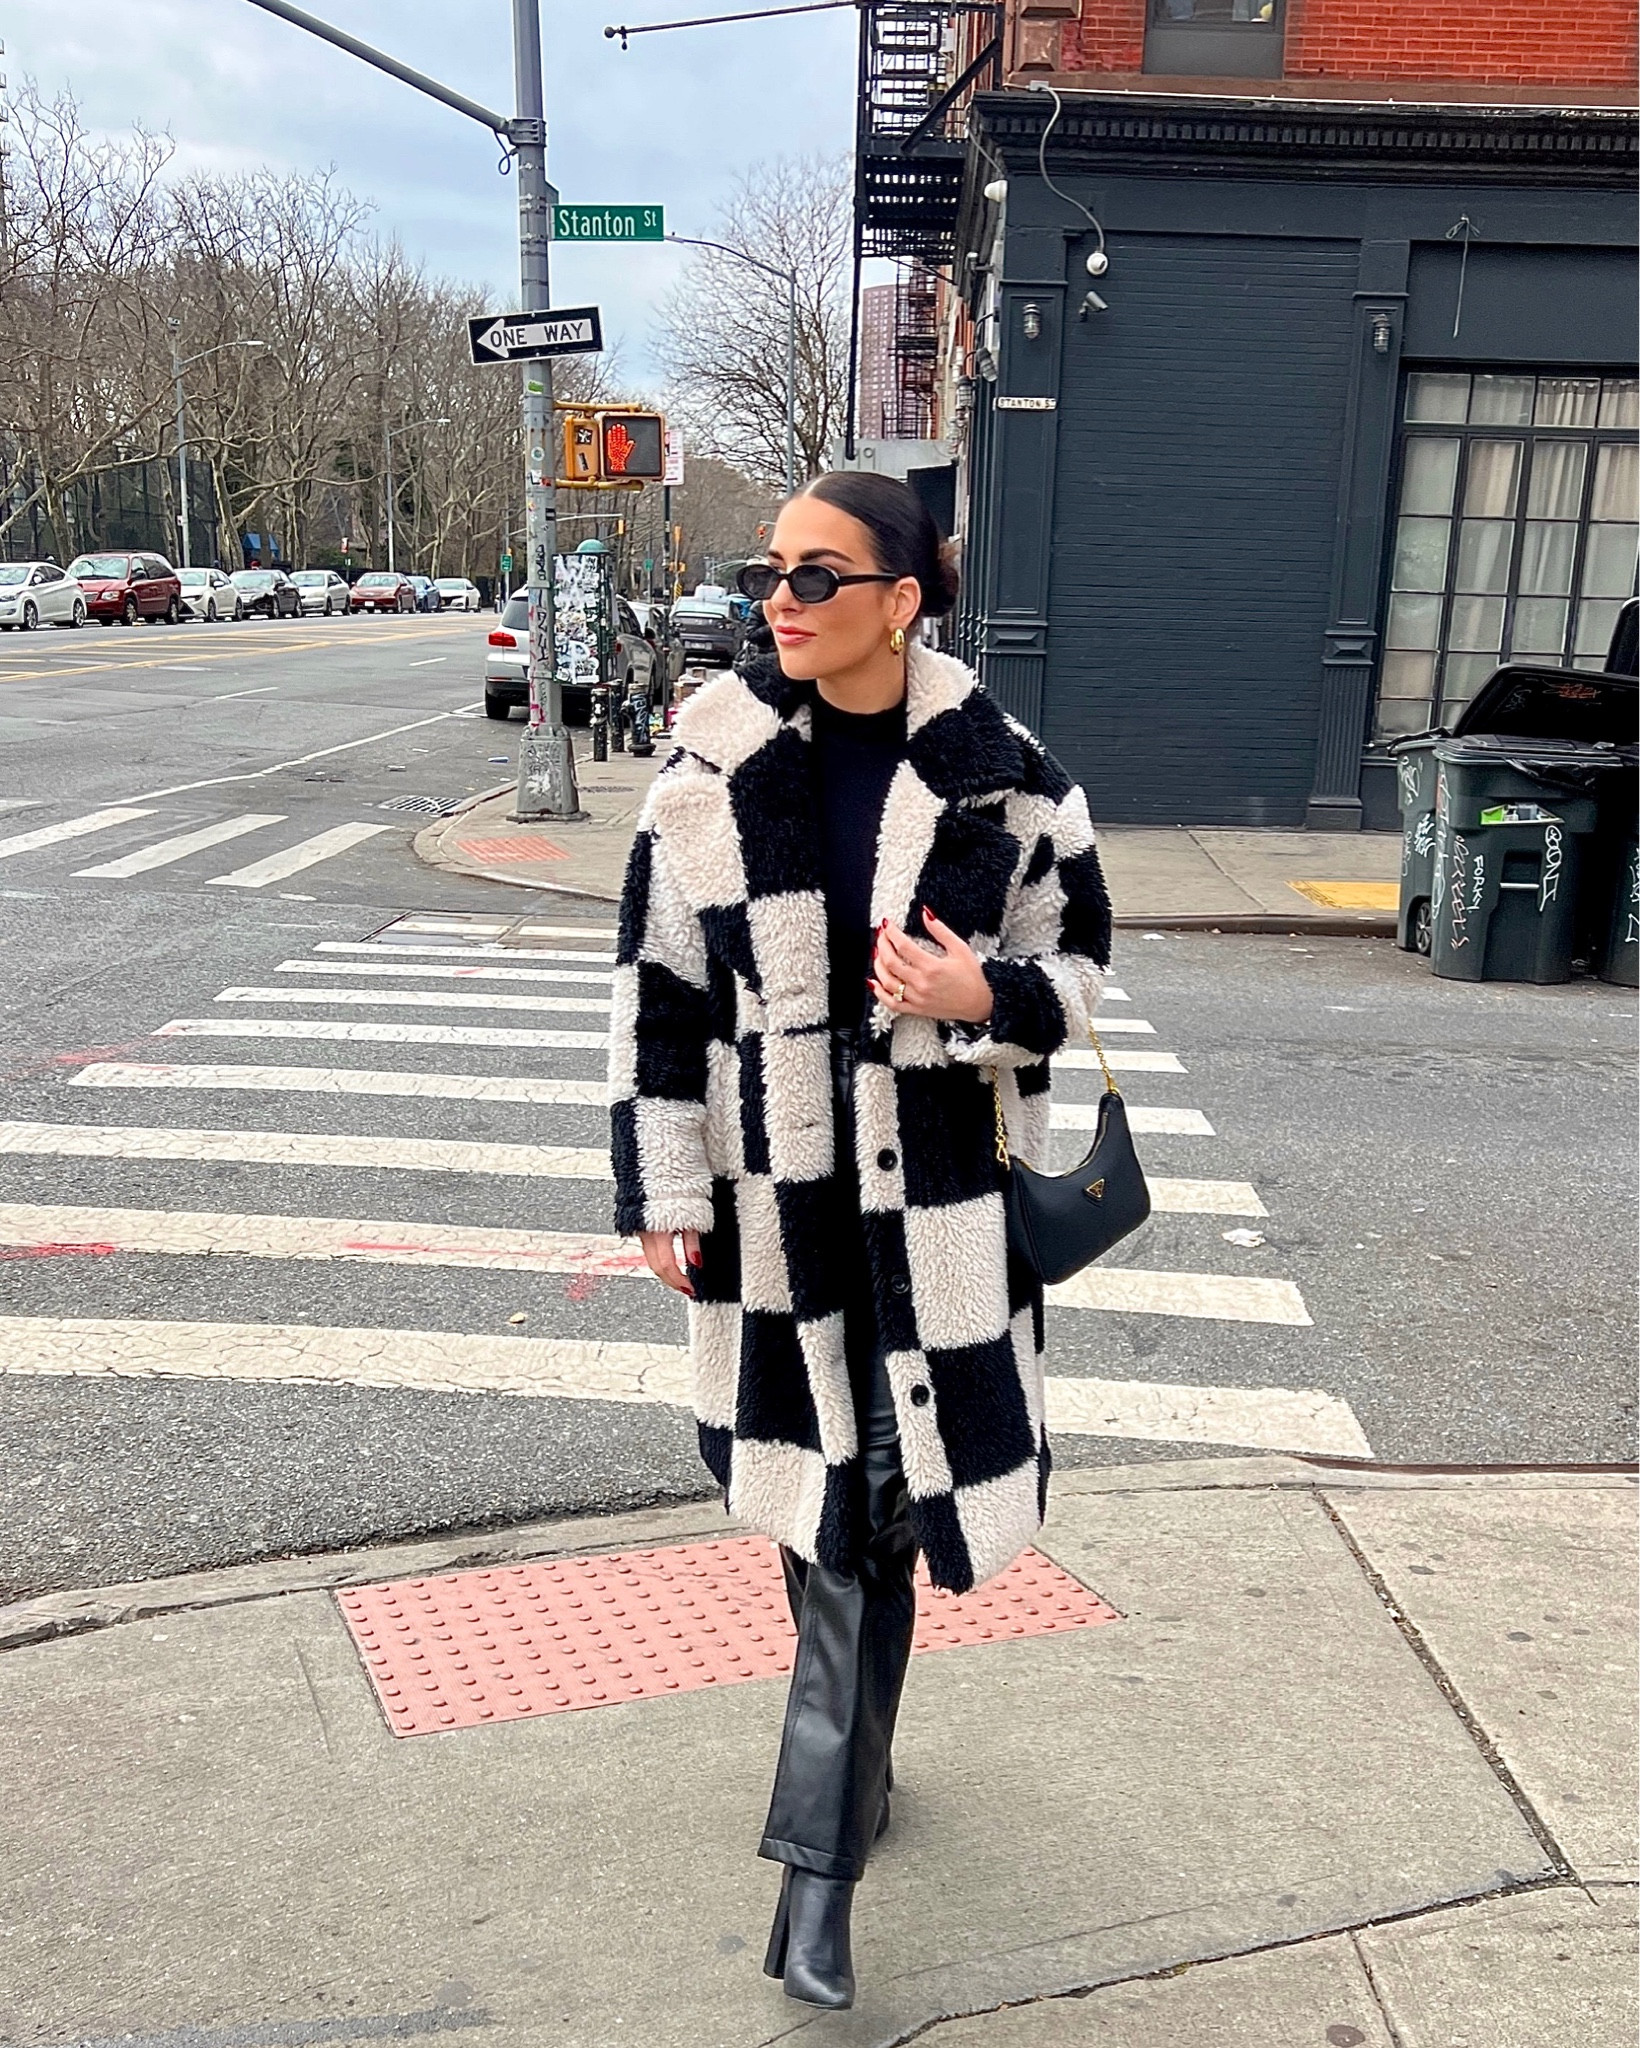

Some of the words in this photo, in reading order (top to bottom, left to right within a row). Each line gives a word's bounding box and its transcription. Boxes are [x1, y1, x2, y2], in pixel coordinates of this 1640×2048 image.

[559, 209, 635, 236] Stanton
[643, 209, 657, 227] St
[490, 328, 527, 348] ONE
[544, 322, 583, 342] WAY
[1000, 398, 1041, 408] STANTON
